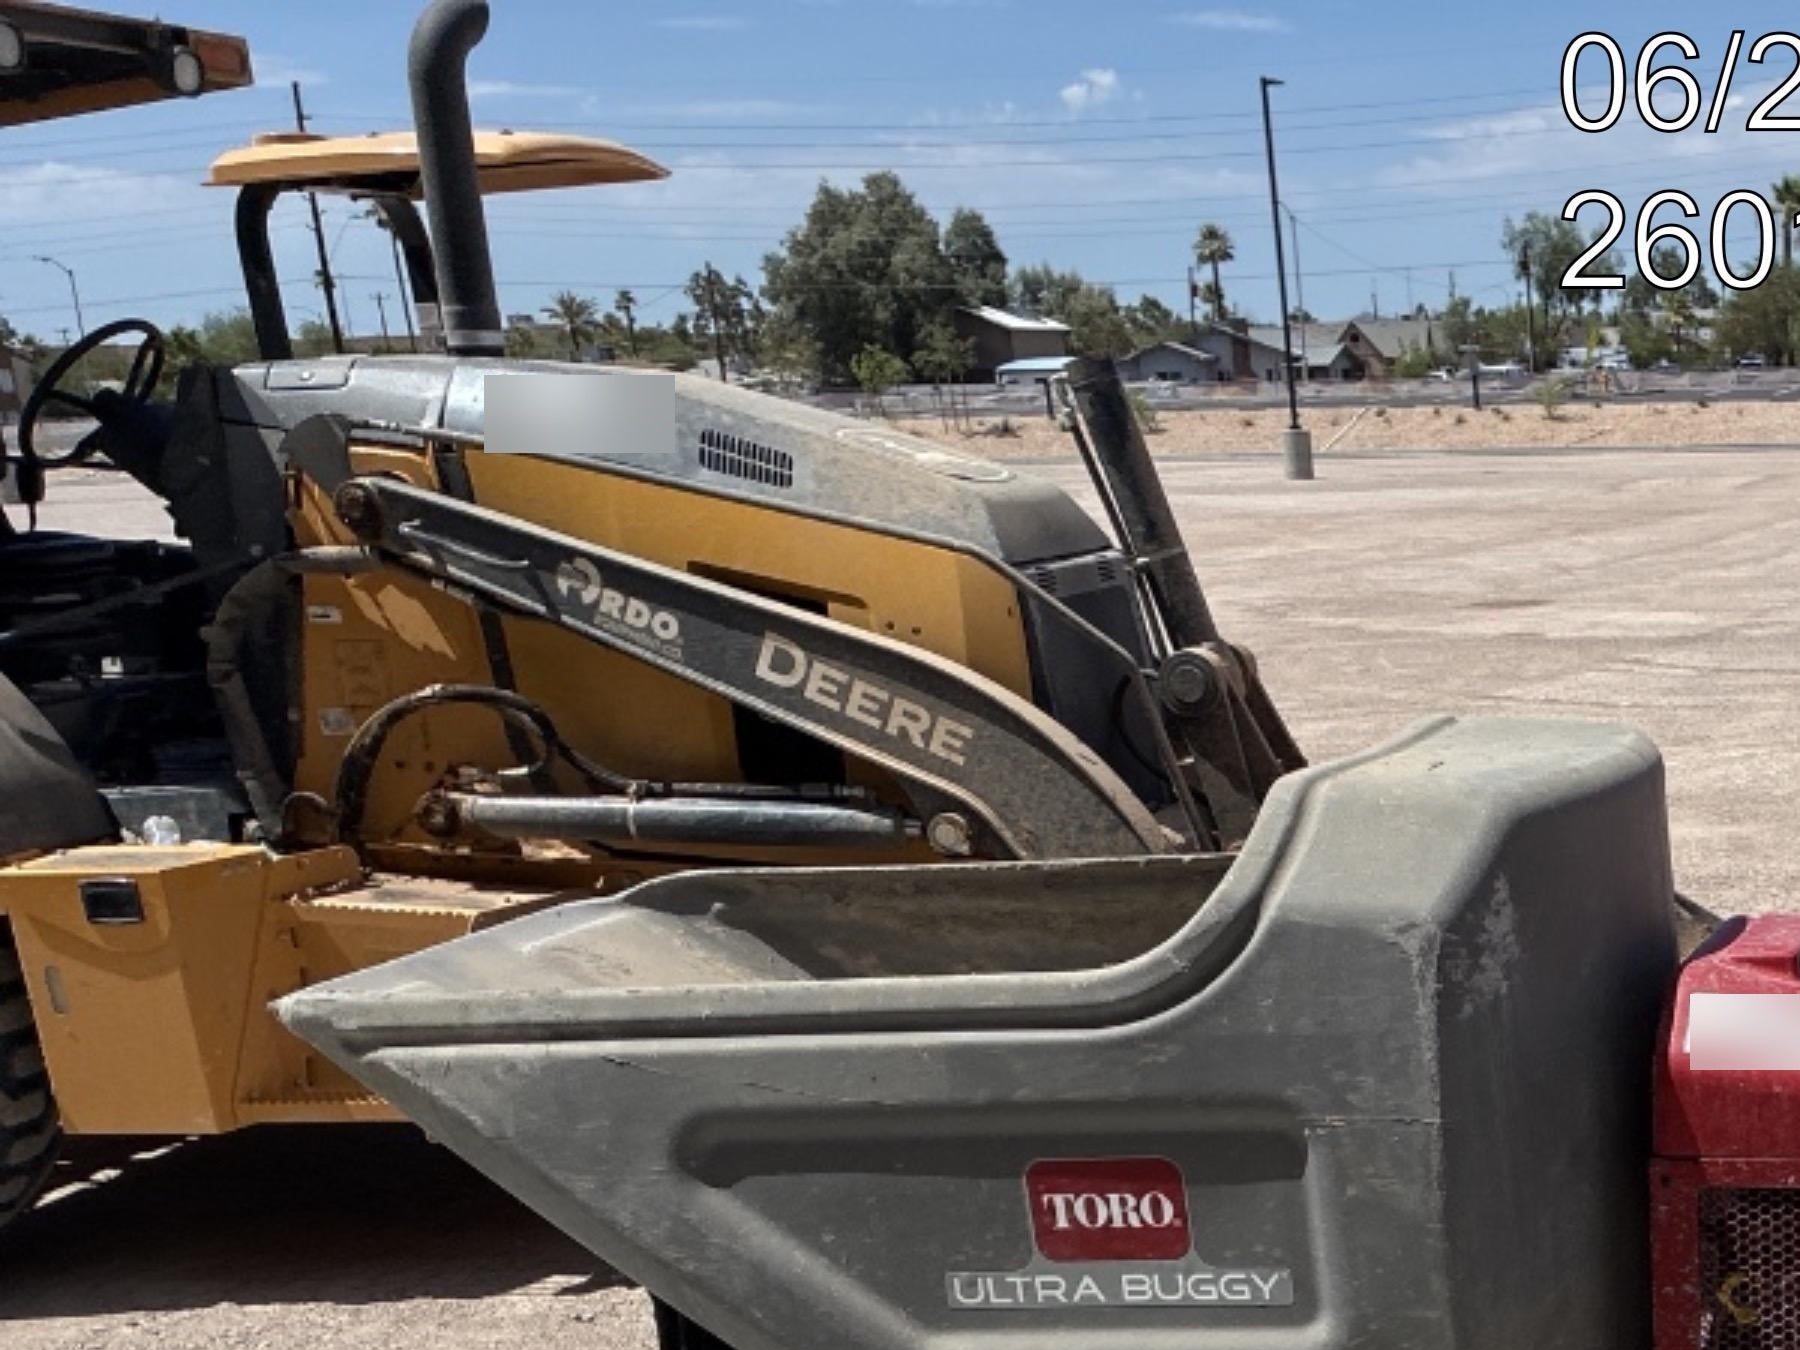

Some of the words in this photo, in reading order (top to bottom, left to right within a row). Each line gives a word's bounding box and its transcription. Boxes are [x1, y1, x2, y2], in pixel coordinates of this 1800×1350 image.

[599, 587, 680, 640] RDO
[755, 630, 975, 765] DEERE
[1042, 1190, 1175, 1230] TORO
[952, 1274, 1105, 1304] ULTRA
[1120, 1272, 1288, 1301] BUGGY
